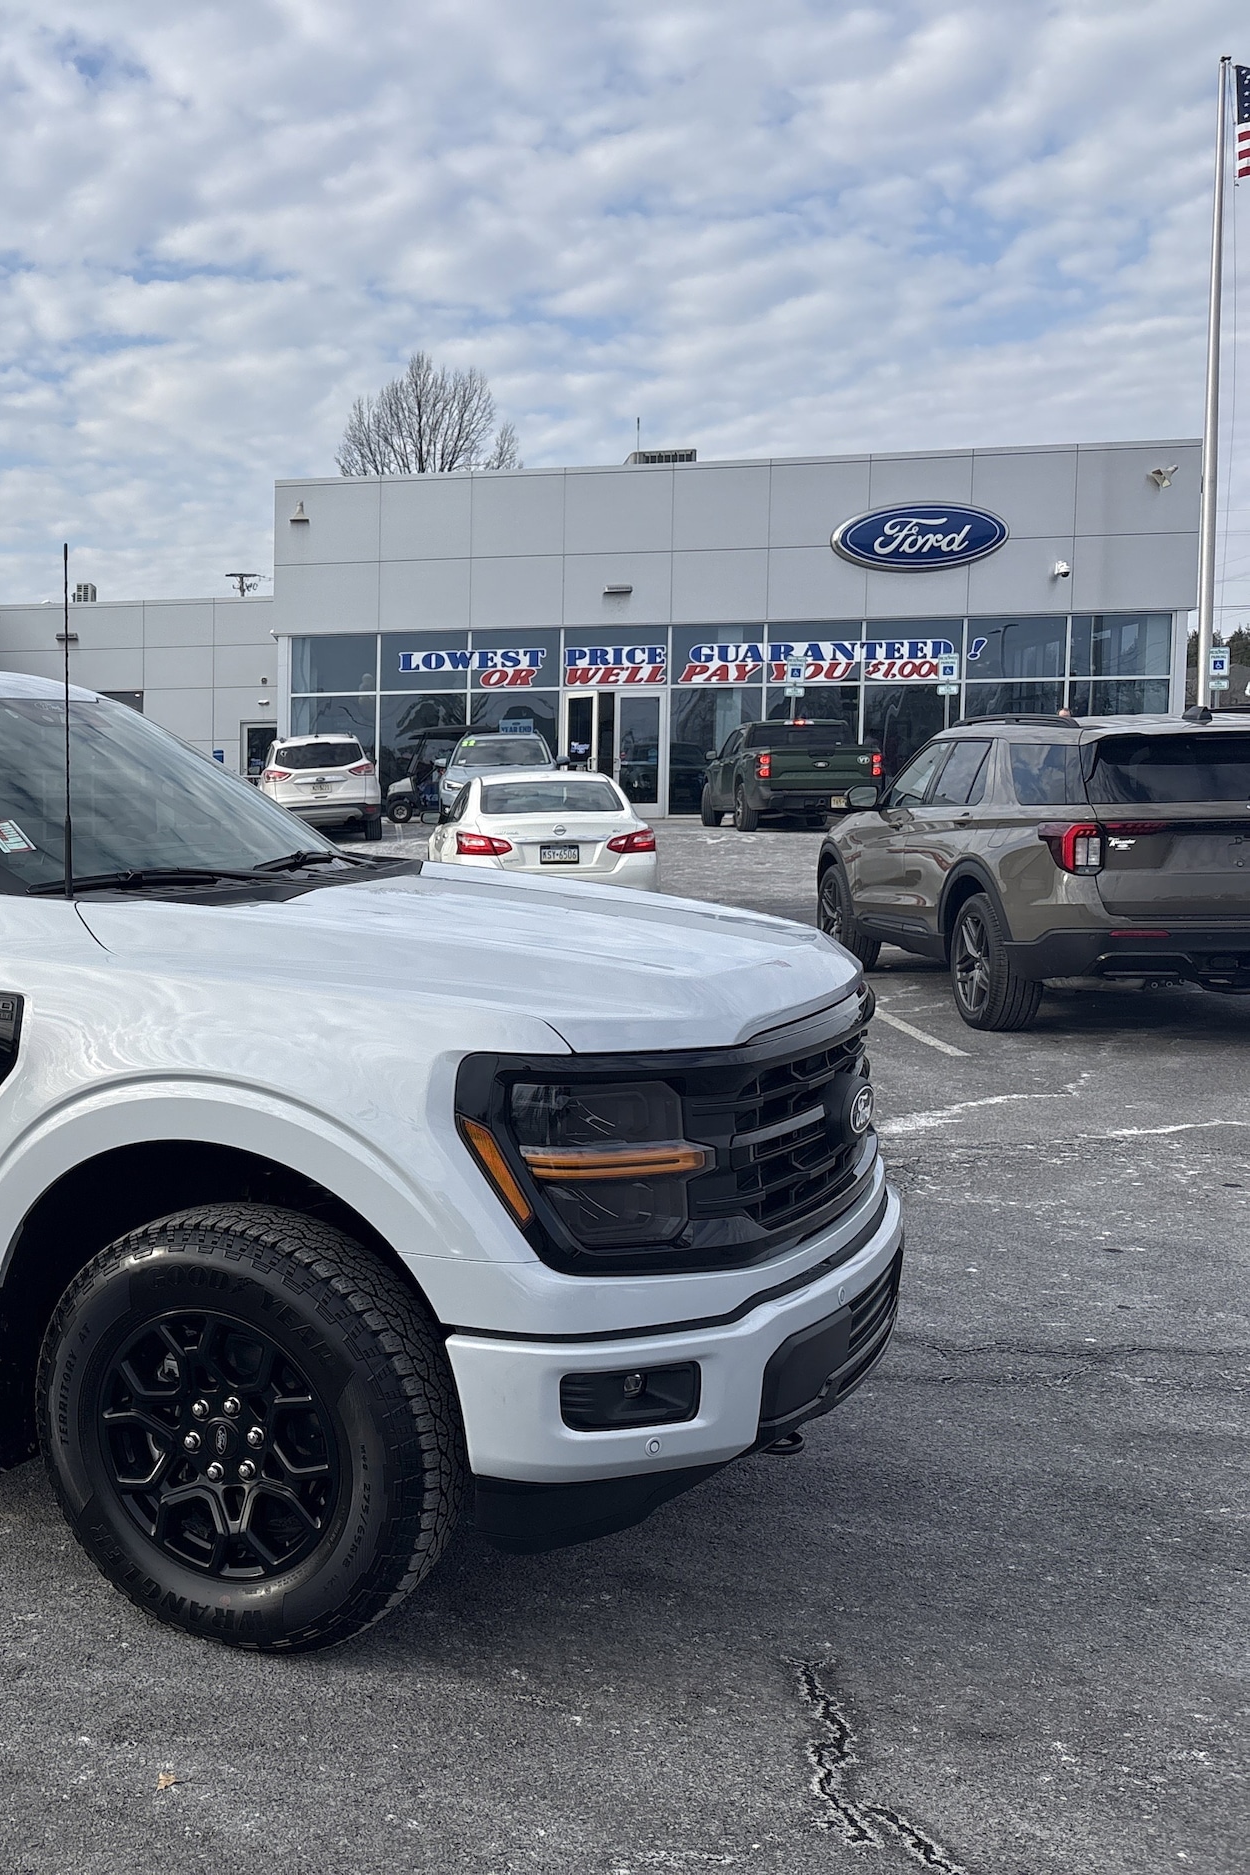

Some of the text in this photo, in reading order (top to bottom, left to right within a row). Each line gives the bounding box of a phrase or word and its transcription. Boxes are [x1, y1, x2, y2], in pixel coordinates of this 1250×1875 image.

[873, 517, 972, 555] Ford
[400, 649, 546, 672] LOWEST
[565, 646, 665, 666] PRICE
[690, 640, 953, 663] GUARANTEED
[481, 660, 939, 687] OR WE'LL PAY YOU $1,00
[855, 1093, 872, 1127] Ford
[58, 1349, 78, 1446] TERRITORY
[217, 1428, 226, 1451] Ford
[88, 1522, 270, 1634] WRANGLER
